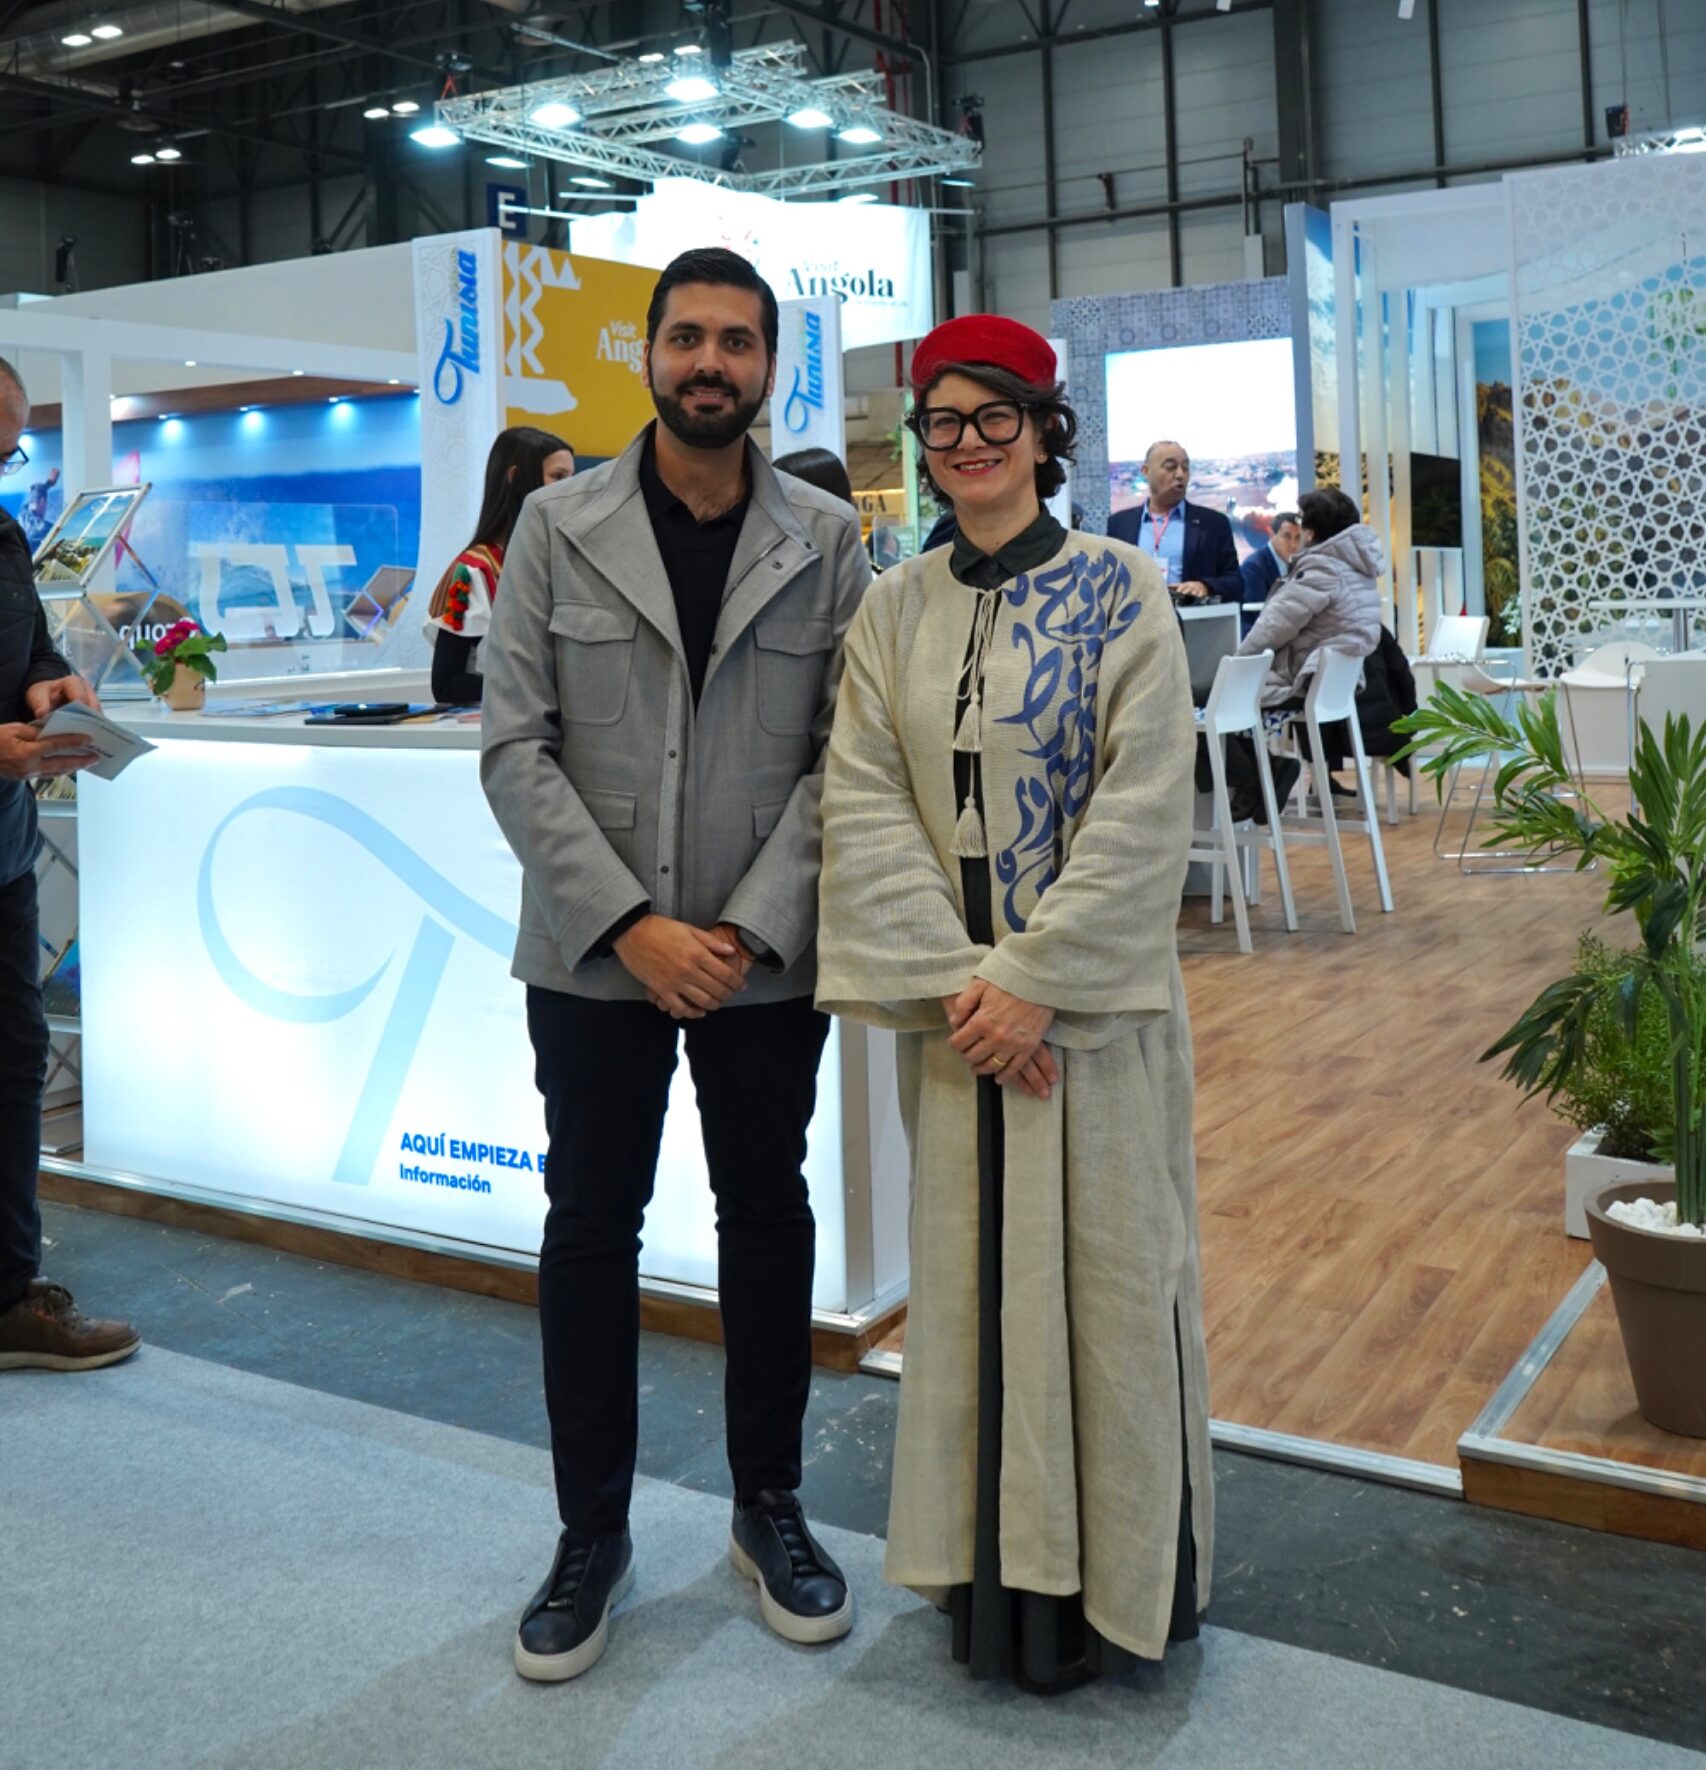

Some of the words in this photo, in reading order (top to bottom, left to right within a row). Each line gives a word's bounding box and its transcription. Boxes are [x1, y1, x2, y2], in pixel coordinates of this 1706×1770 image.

[498, 192, 516, 230] E
[786, 268, 894, 304] Angola
[434, 249, 480, 405] Tunisia
[609, 320, 637, 337] Visit
[784, 311, 822, 432] Tunisia
[400, 1132, 446, 1156] AQUÍ
[449, 1139, 533, 1172] EMPIEZA
[400, 1163, 491, 1193] Información
